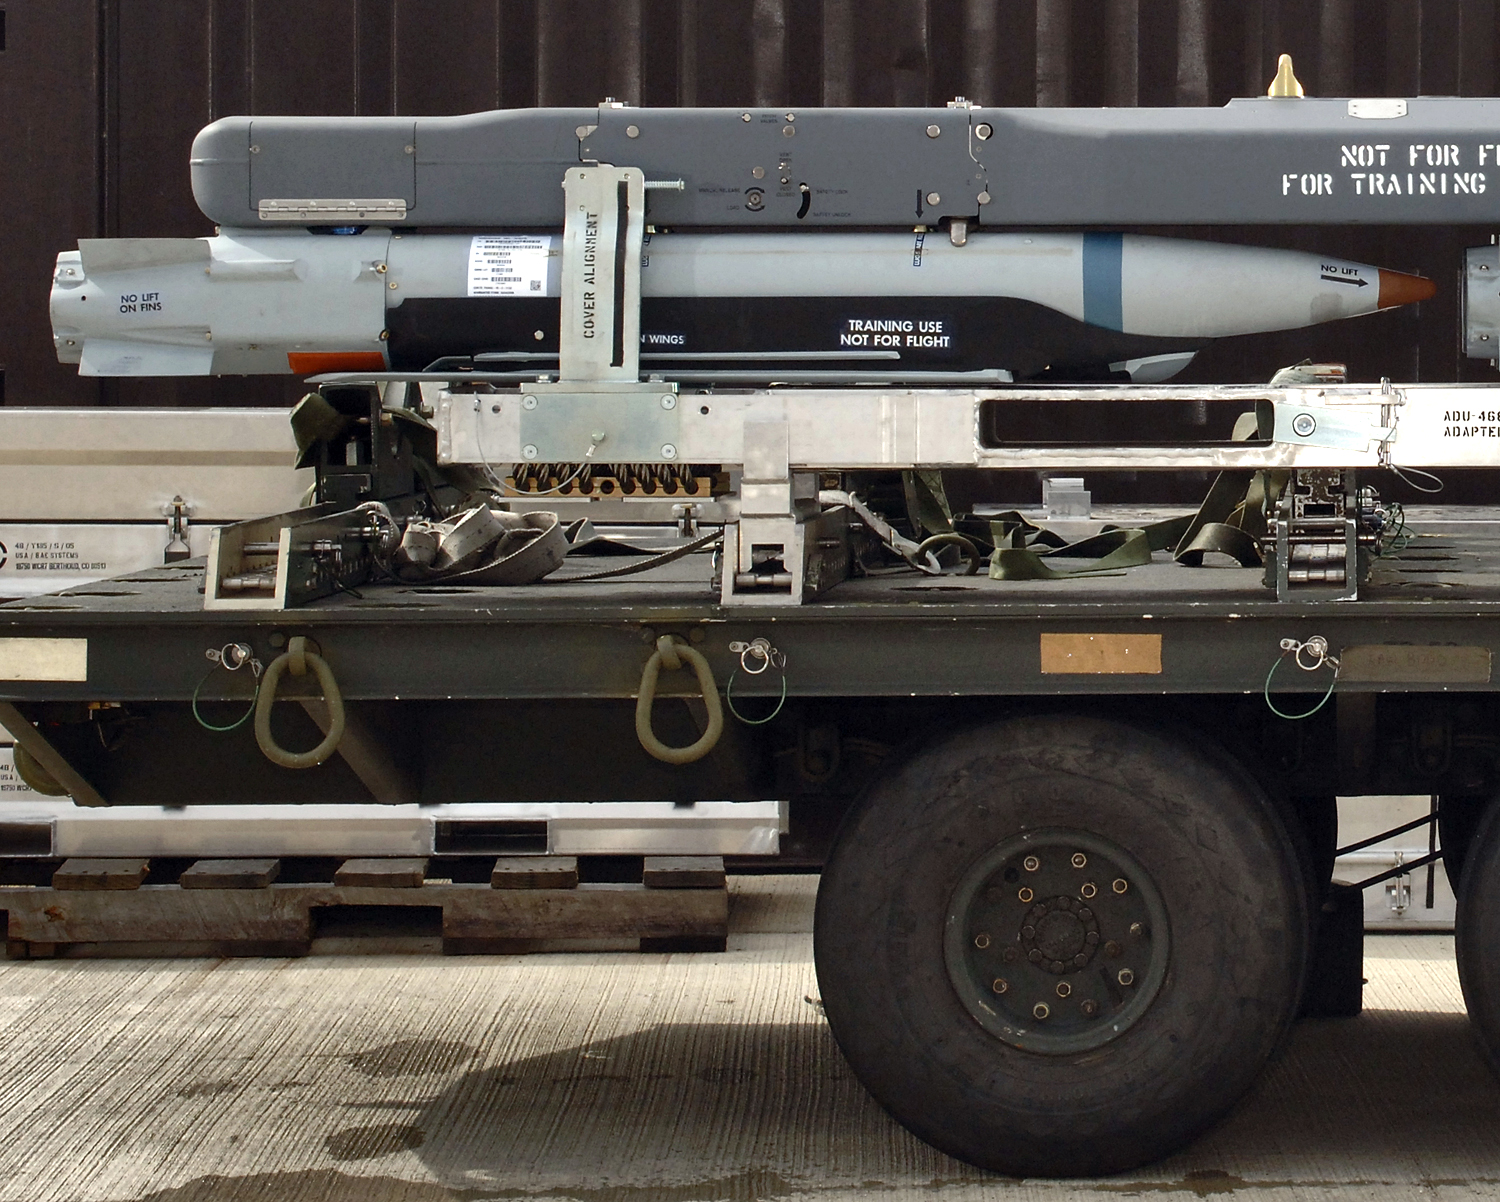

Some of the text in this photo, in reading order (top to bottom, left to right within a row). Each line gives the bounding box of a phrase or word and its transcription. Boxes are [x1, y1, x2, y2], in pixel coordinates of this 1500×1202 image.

[1341, 144, 1391, 167] NOT
[1409, 144, 1460, 166] FOR
[1282, 173, 1333, 195] FOR
[1351, 173, 1486, 195] TRAINING
[583, 212, 598, 339] COVER ALIGNMENT
[1320, 264, 1359, 276] NO LIFT
[121, 292, 159, 303] NO LIFT
[120, 302, 162, 313] ON FINS
[849, 319, 943, 333] TRAINING USE
[649, 334, 685, 345] WINGS
[840, 334, 950, 348] NOT FOR FLIGHT
